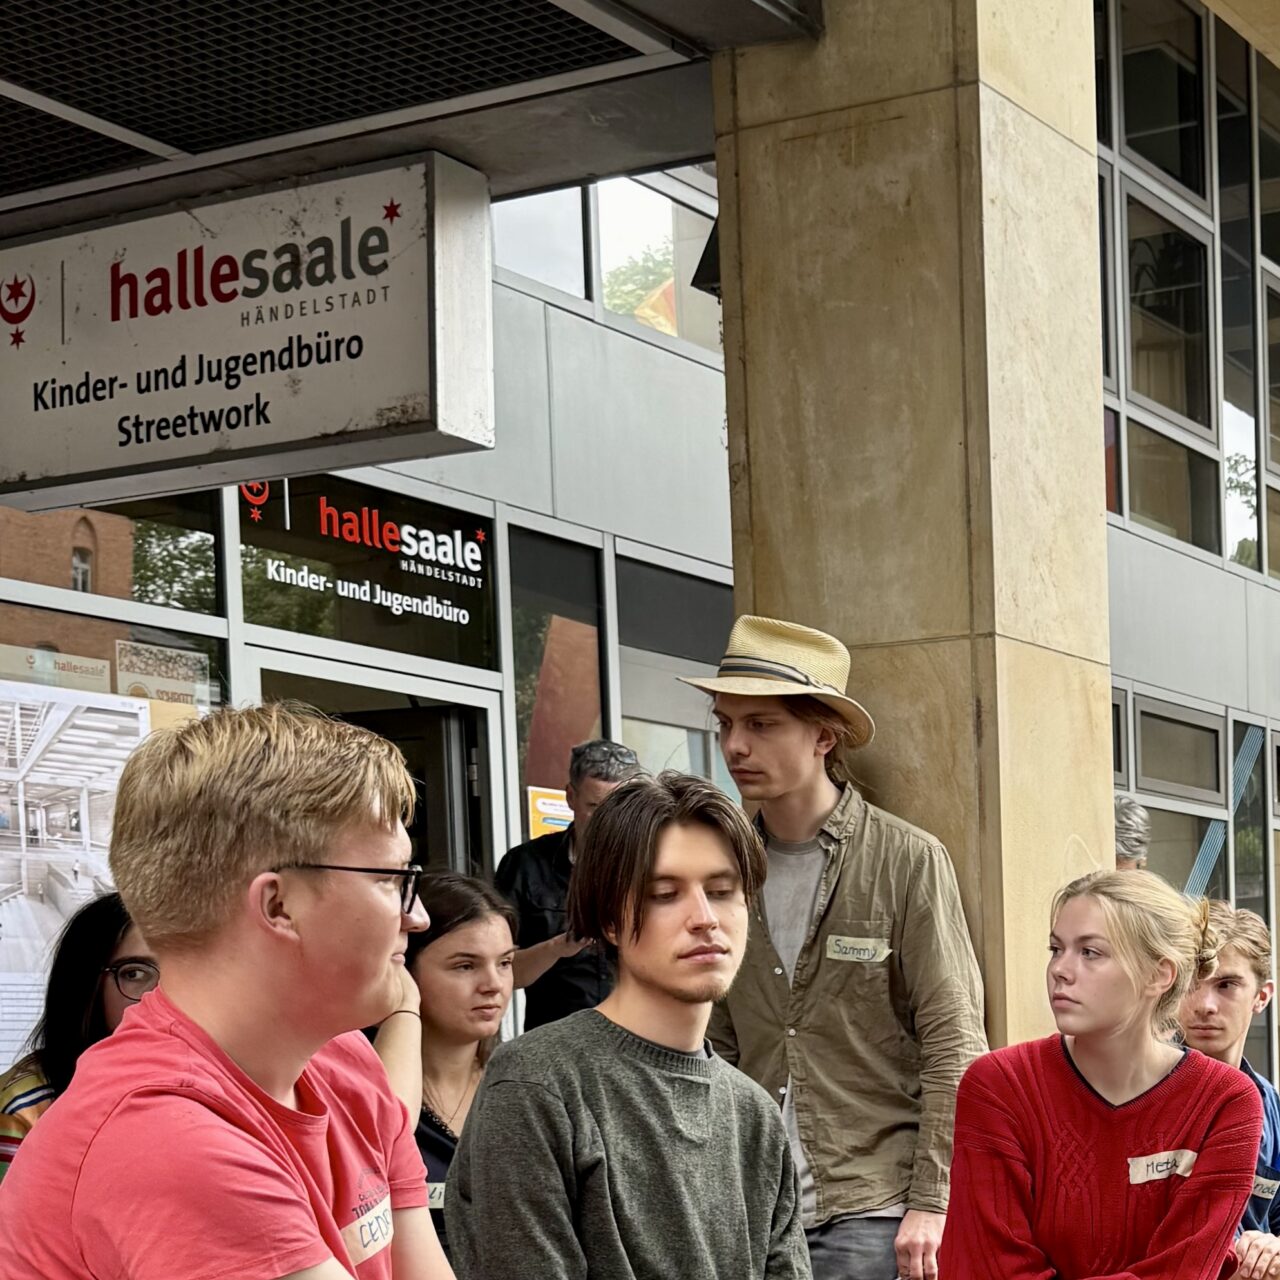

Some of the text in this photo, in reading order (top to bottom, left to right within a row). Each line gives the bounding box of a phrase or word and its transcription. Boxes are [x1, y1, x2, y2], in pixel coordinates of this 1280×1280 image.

[110, 216, 390, 322] hallesaale
[240, 285, 391, 327] HÄNDELSTADT
[33, 333, 363, 411] Kinder- und Jugendbüro
[117, 393, 271, 447] Streetwork
[319, 496, 482, 572] hallesaale
[267, 558, 470, 625] Kinder- und Jugendbüro
[401, 560, 483, 588] HÄNDELSTADT
[833, 939, 877, 960] Sammy
